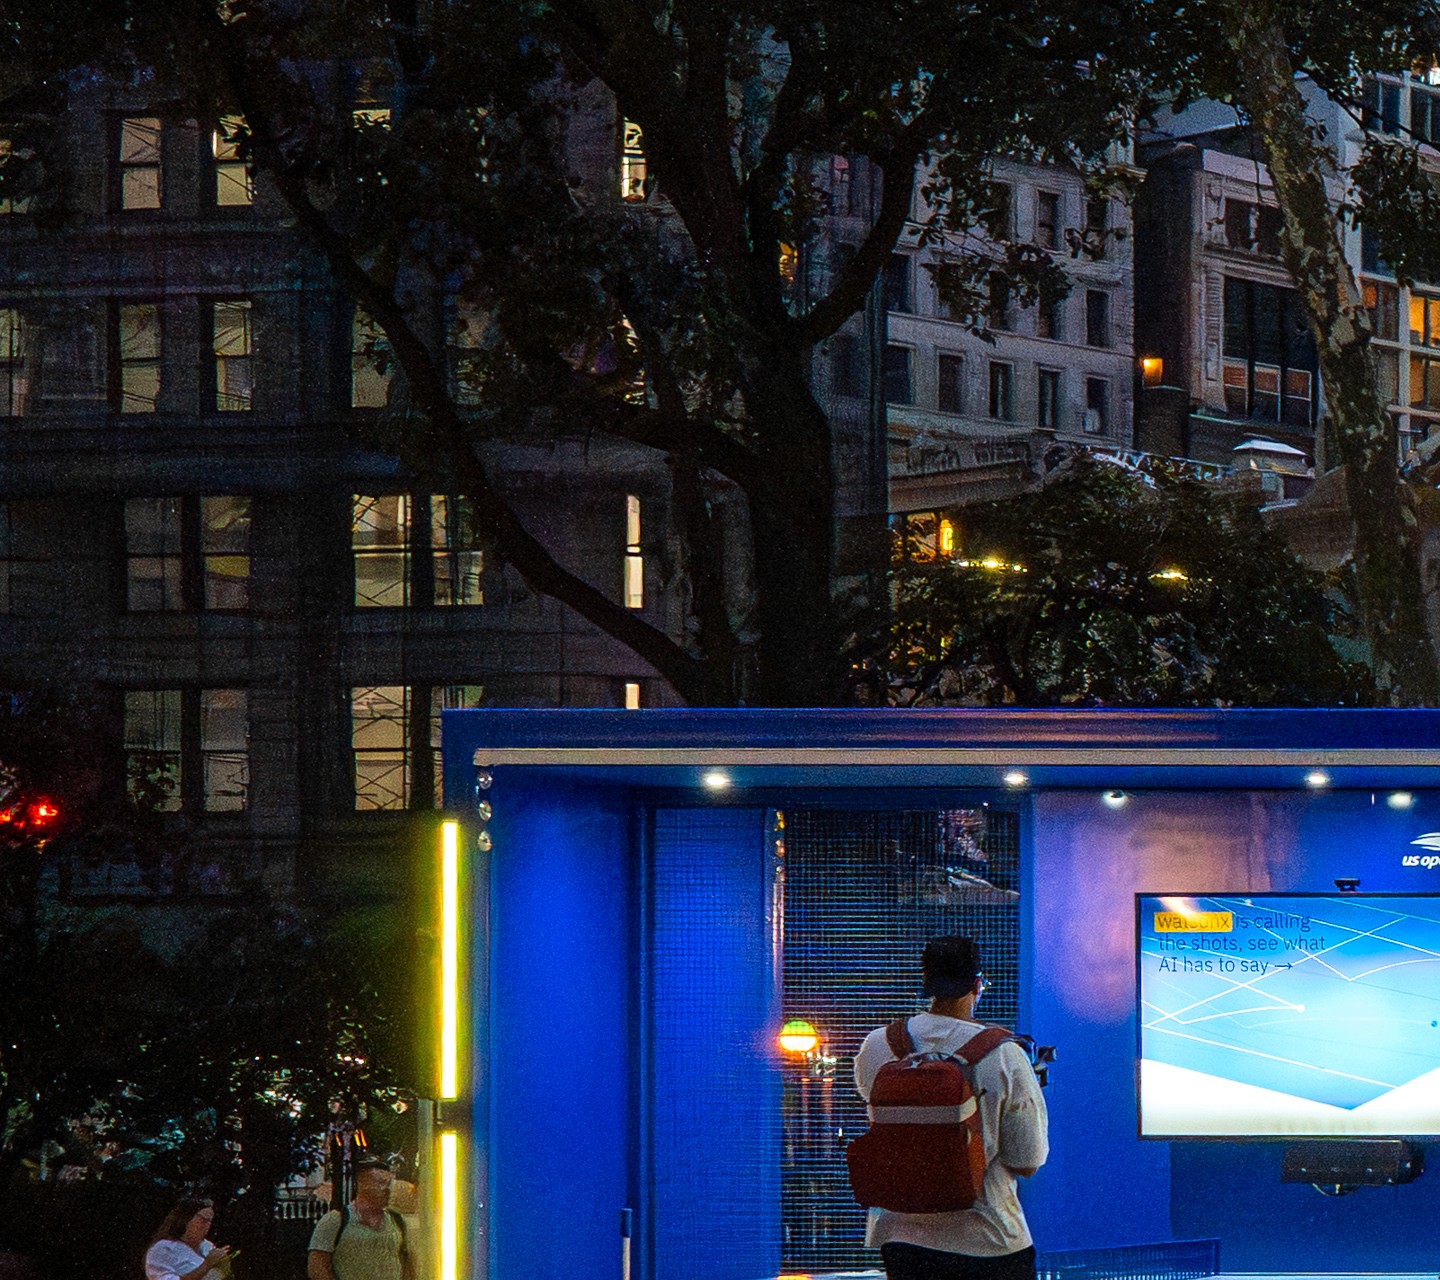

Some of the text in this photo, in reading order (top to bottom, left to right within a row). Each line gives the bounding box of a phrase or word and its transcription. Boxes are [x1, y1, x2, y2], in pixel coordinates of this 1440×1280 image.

[1402, 855, 1420, 867] us
[1235, 915, 1249, 928] is
[1253, 913, 1311, 933] calling
[1158, 934, 1326, 953] the shots, see what
[1158, 955, 1269, 976] AI has to say
